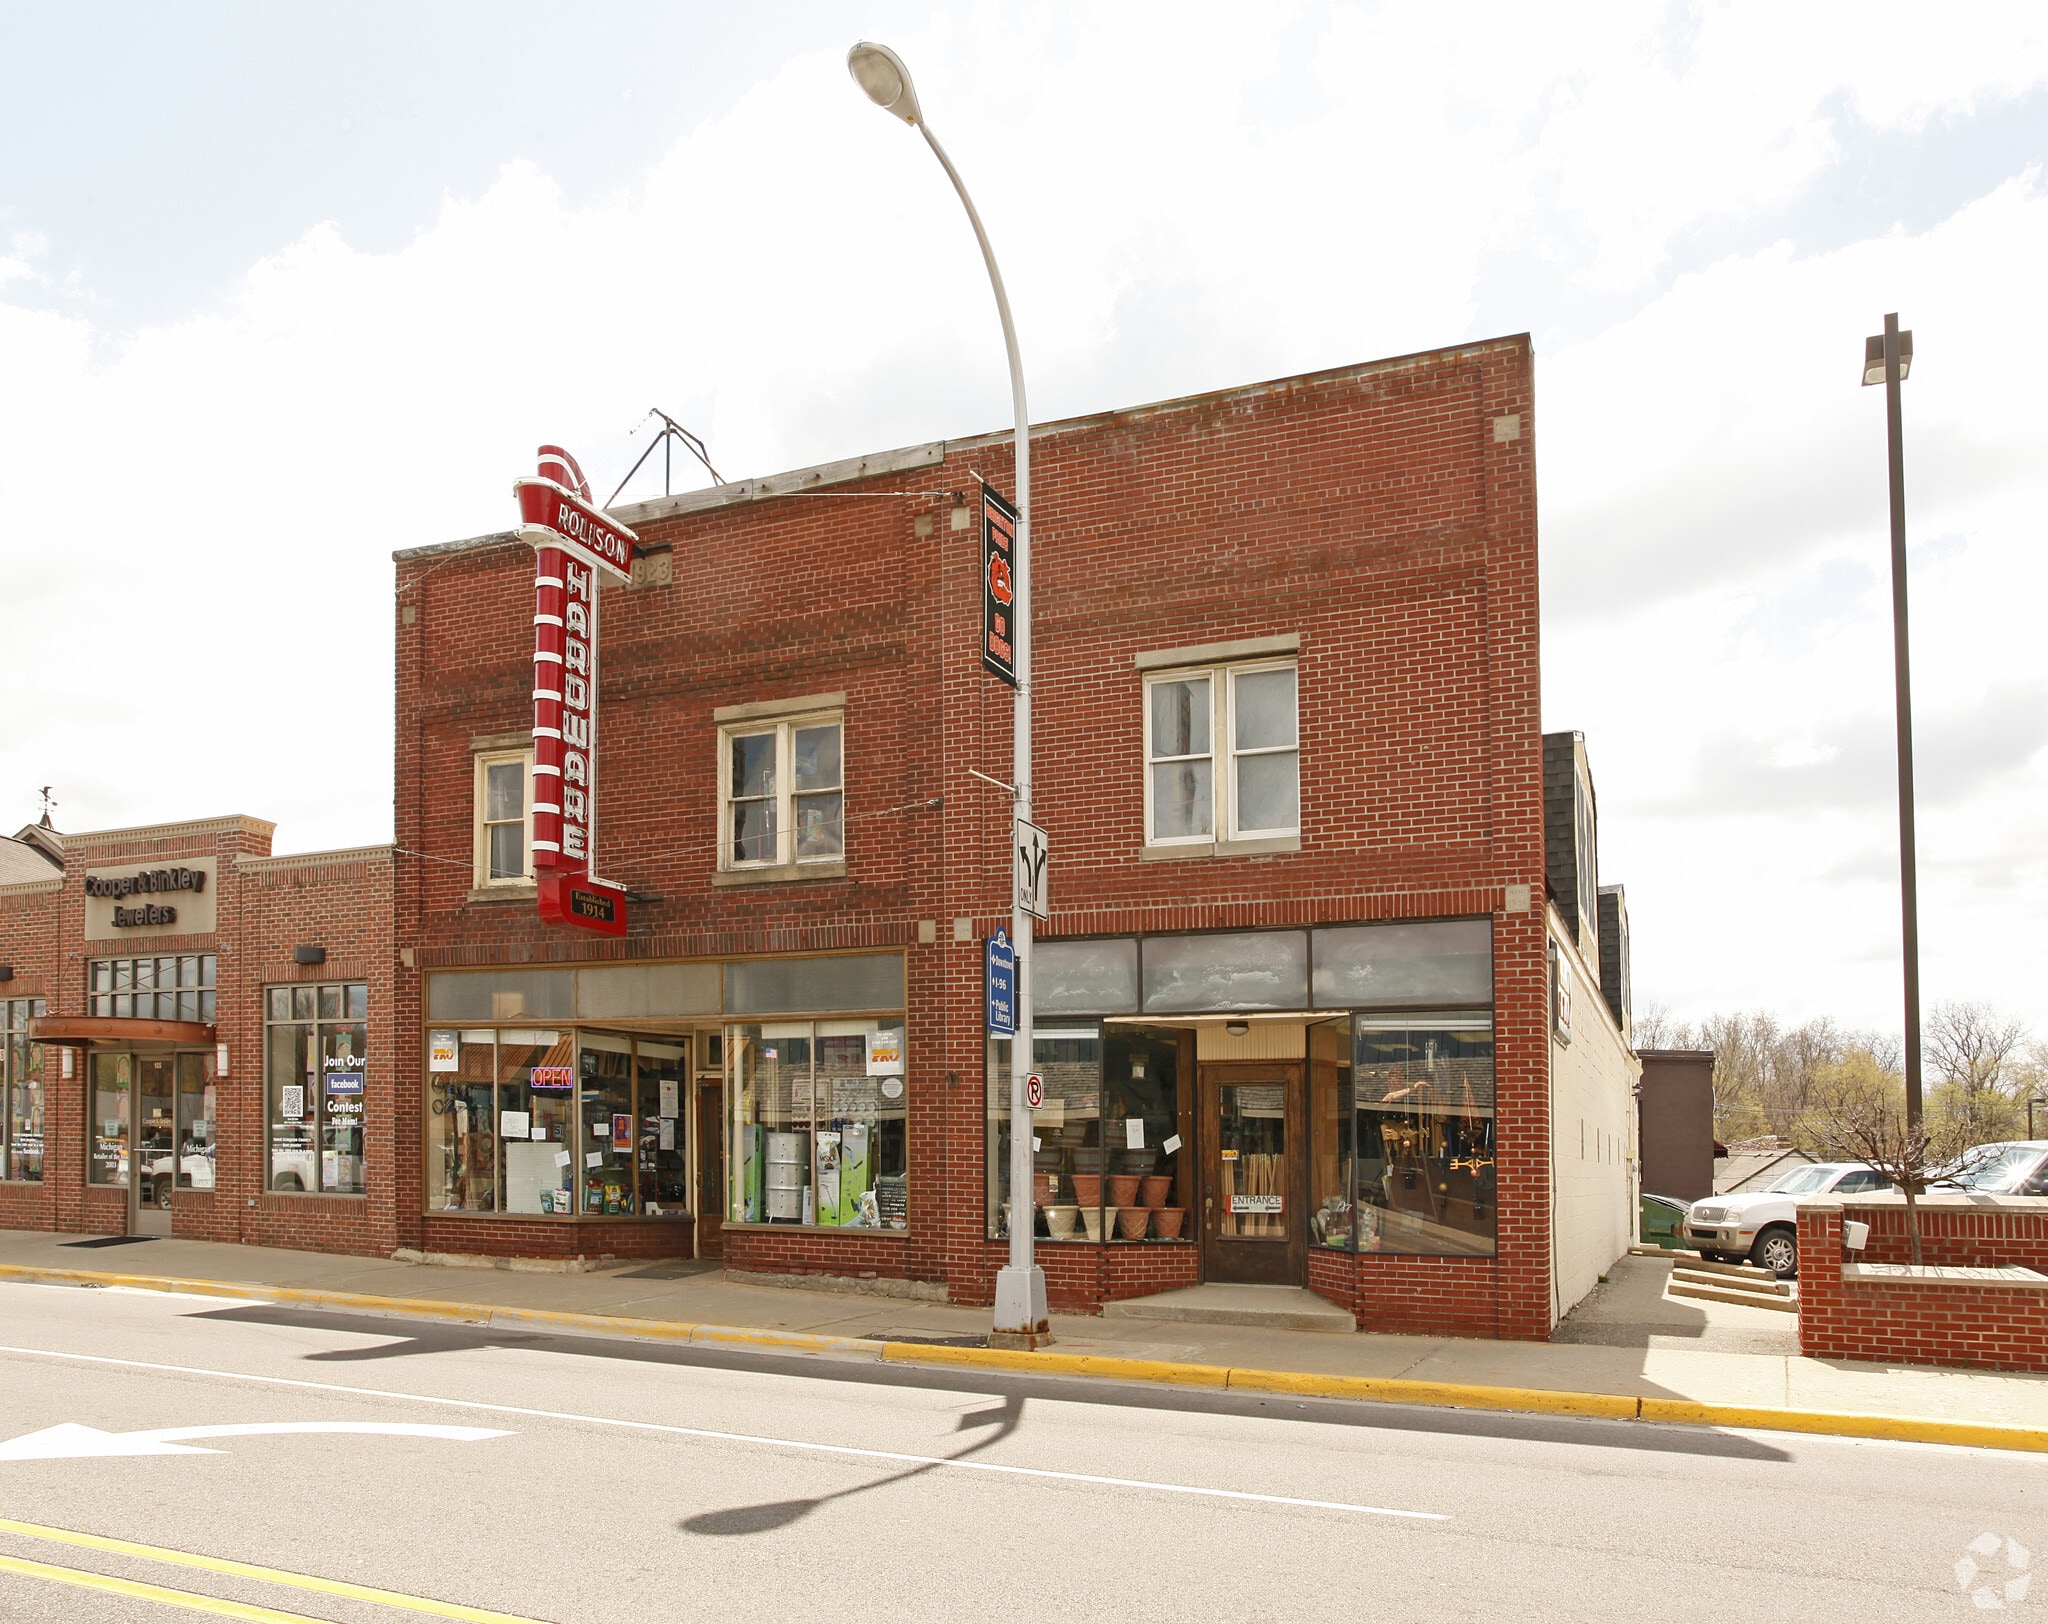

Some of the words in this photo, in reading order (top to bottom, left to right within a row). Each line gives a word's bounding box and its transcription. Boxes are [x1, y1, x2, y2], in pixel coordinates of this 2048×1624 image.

[558, 503, 629, 565] ROLISON
[631, 560, 669, 586] 1923
[995, 612, 1006, 637] GO
[563, 562, 591, 861] HARDWARE
[84, 875, 141, 900] Cooper
[138, 871, 150, 893] &
[150, 867, 205, 894] Binkley
[575, 891, 611, 907] Established
[1021, 887, 1032, 905] ONLY
[111, 904, 177, 928] Jewelers
[582, 902, 605, 919] 1914
[995, 977, 1006, 991] I-96
[995, 999, 1009, 1013] Public
[995, 1010, 1011, 1026] Library
[324, 1055, 344, 1067] Join
[346, 1055, 366, 1067] Our
[331, 1079, 359, 1089] facebook
[533, 1069, 571, 1087] OPEN
[327, 1101, 363, 1113] Contest
[100, 1142, 123, 1153] Michigan
[187, 1144, 211, 1155] Michigan
[1232, 1196, 1281, 1205] ENTRANCE
